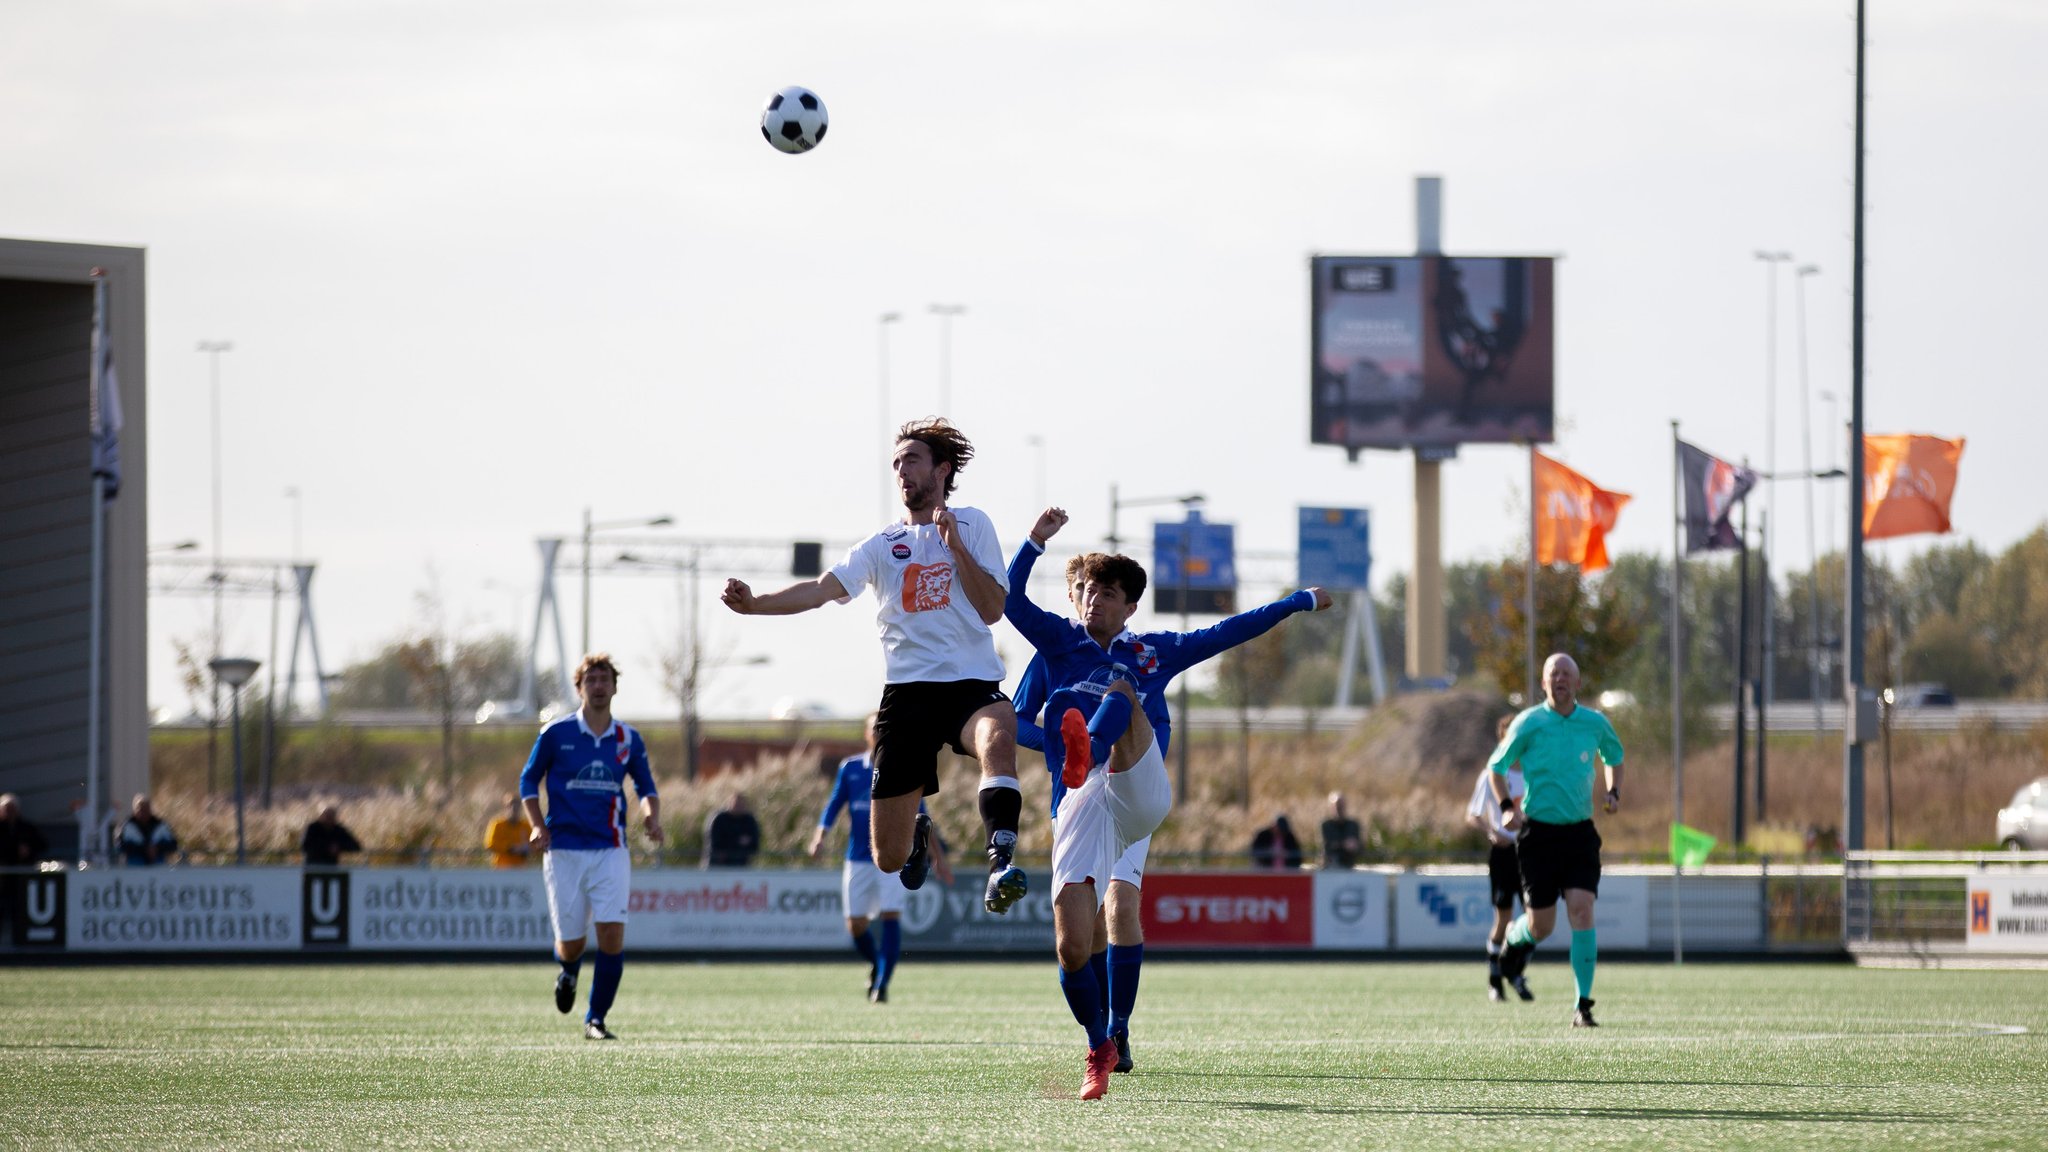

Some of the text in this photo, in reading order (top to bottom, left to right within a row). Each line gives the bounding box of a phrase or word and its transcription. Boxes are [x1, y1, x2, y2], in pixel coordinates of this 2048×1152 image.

[886, 530, 907, 542] hummel
[1080, 683, 1091, 691] THE
[82, 877, 255, 912] adviseurs
[364, 877, 533, 911] adviseurs
[1155, 896, 1289, 924] STERN
[82, 913, 291, 942] accountants
[364, 913, 548, 942] accountant
